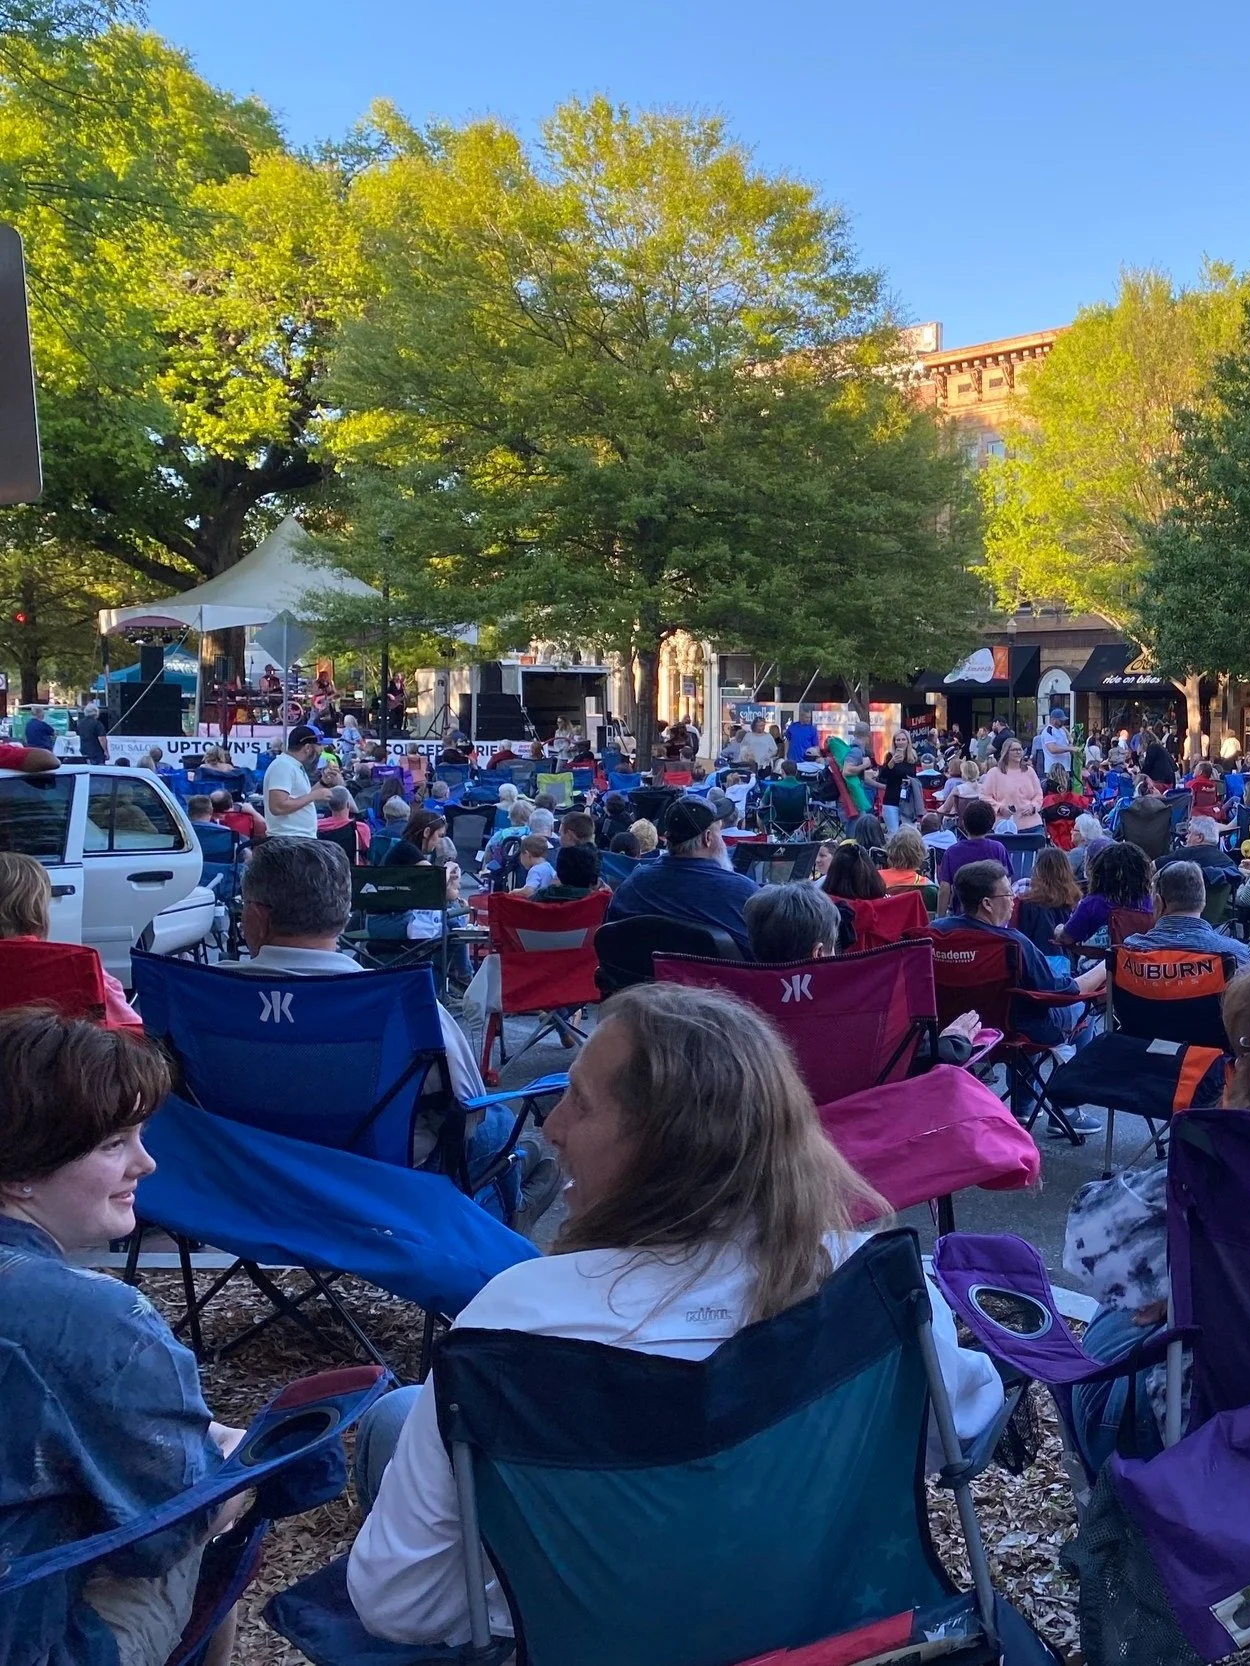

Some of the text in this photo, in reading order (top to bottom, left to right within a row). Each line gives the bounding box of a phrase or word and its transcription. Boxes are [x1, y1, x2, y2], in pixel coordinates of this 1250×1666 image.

[1102, 675, 1122, 684] ride
[1136, 675, 1162, 684] bikes
[1123, 957, 1215, 980] AUBURN
[686, 1307, 732, 1321] KÜHL
